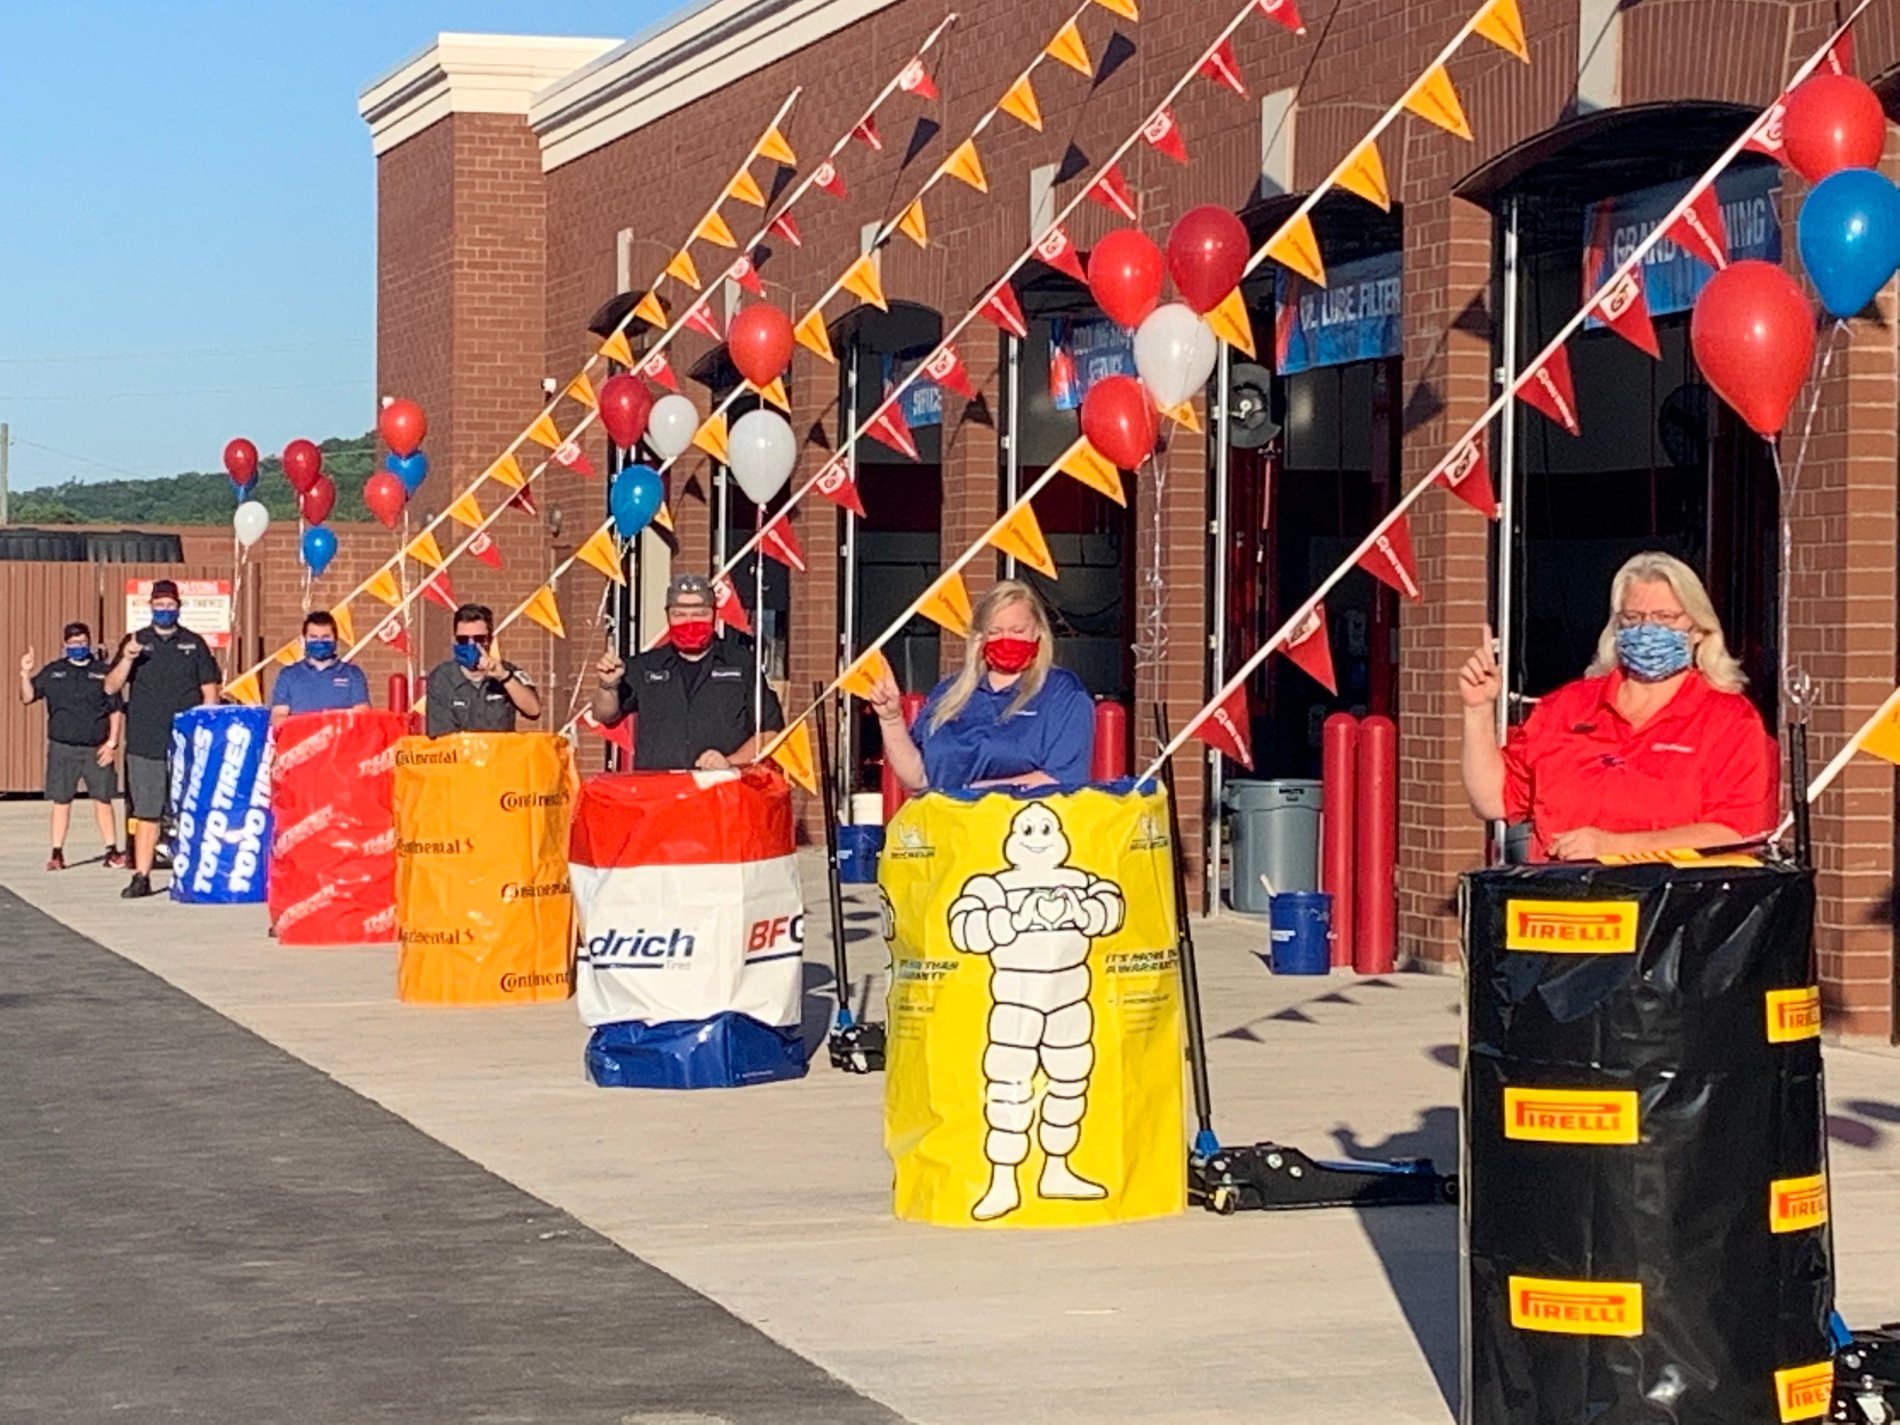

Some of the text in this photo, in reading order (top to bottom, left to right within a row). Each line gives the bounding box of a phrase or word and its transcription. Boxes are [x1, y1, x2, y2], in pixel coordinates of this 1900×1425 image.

[193, 722, 252, 894] TOYO TIRES
[228, 808, 267, 894] TOYO
[1518, 911, 1623, 941] PIRELLI
[588, 928, 696, 958] drich
[1515, 1100, 1622, 1131] PIRELLI
[1520, 1290, 1626, 1323] PIRELLI
